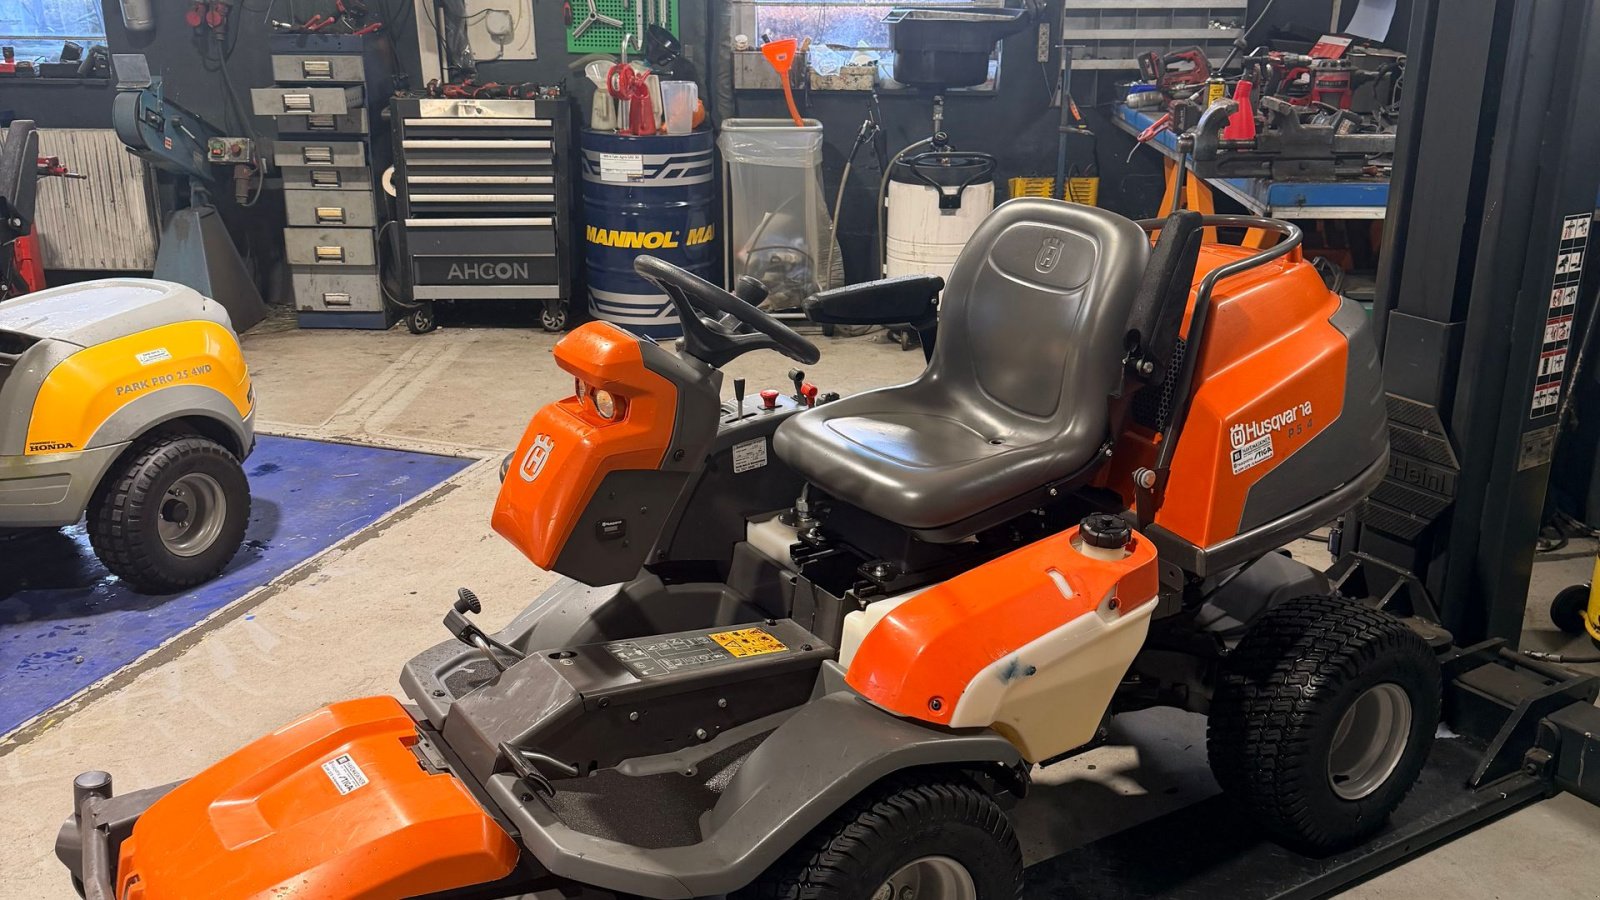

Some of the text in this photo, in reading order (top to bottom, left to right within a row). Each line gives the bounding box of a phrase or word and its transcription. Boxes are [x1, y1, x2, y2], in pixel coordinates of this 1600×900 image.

[586, 225, 678, 249] MANNOL
[686, 223, 715, 246] MA
[447, 262, 528, 280] AHCON
[116, 364, 212, 395] PARK PRO 25 4WD
[30, 443, 74, 452] HONDA
